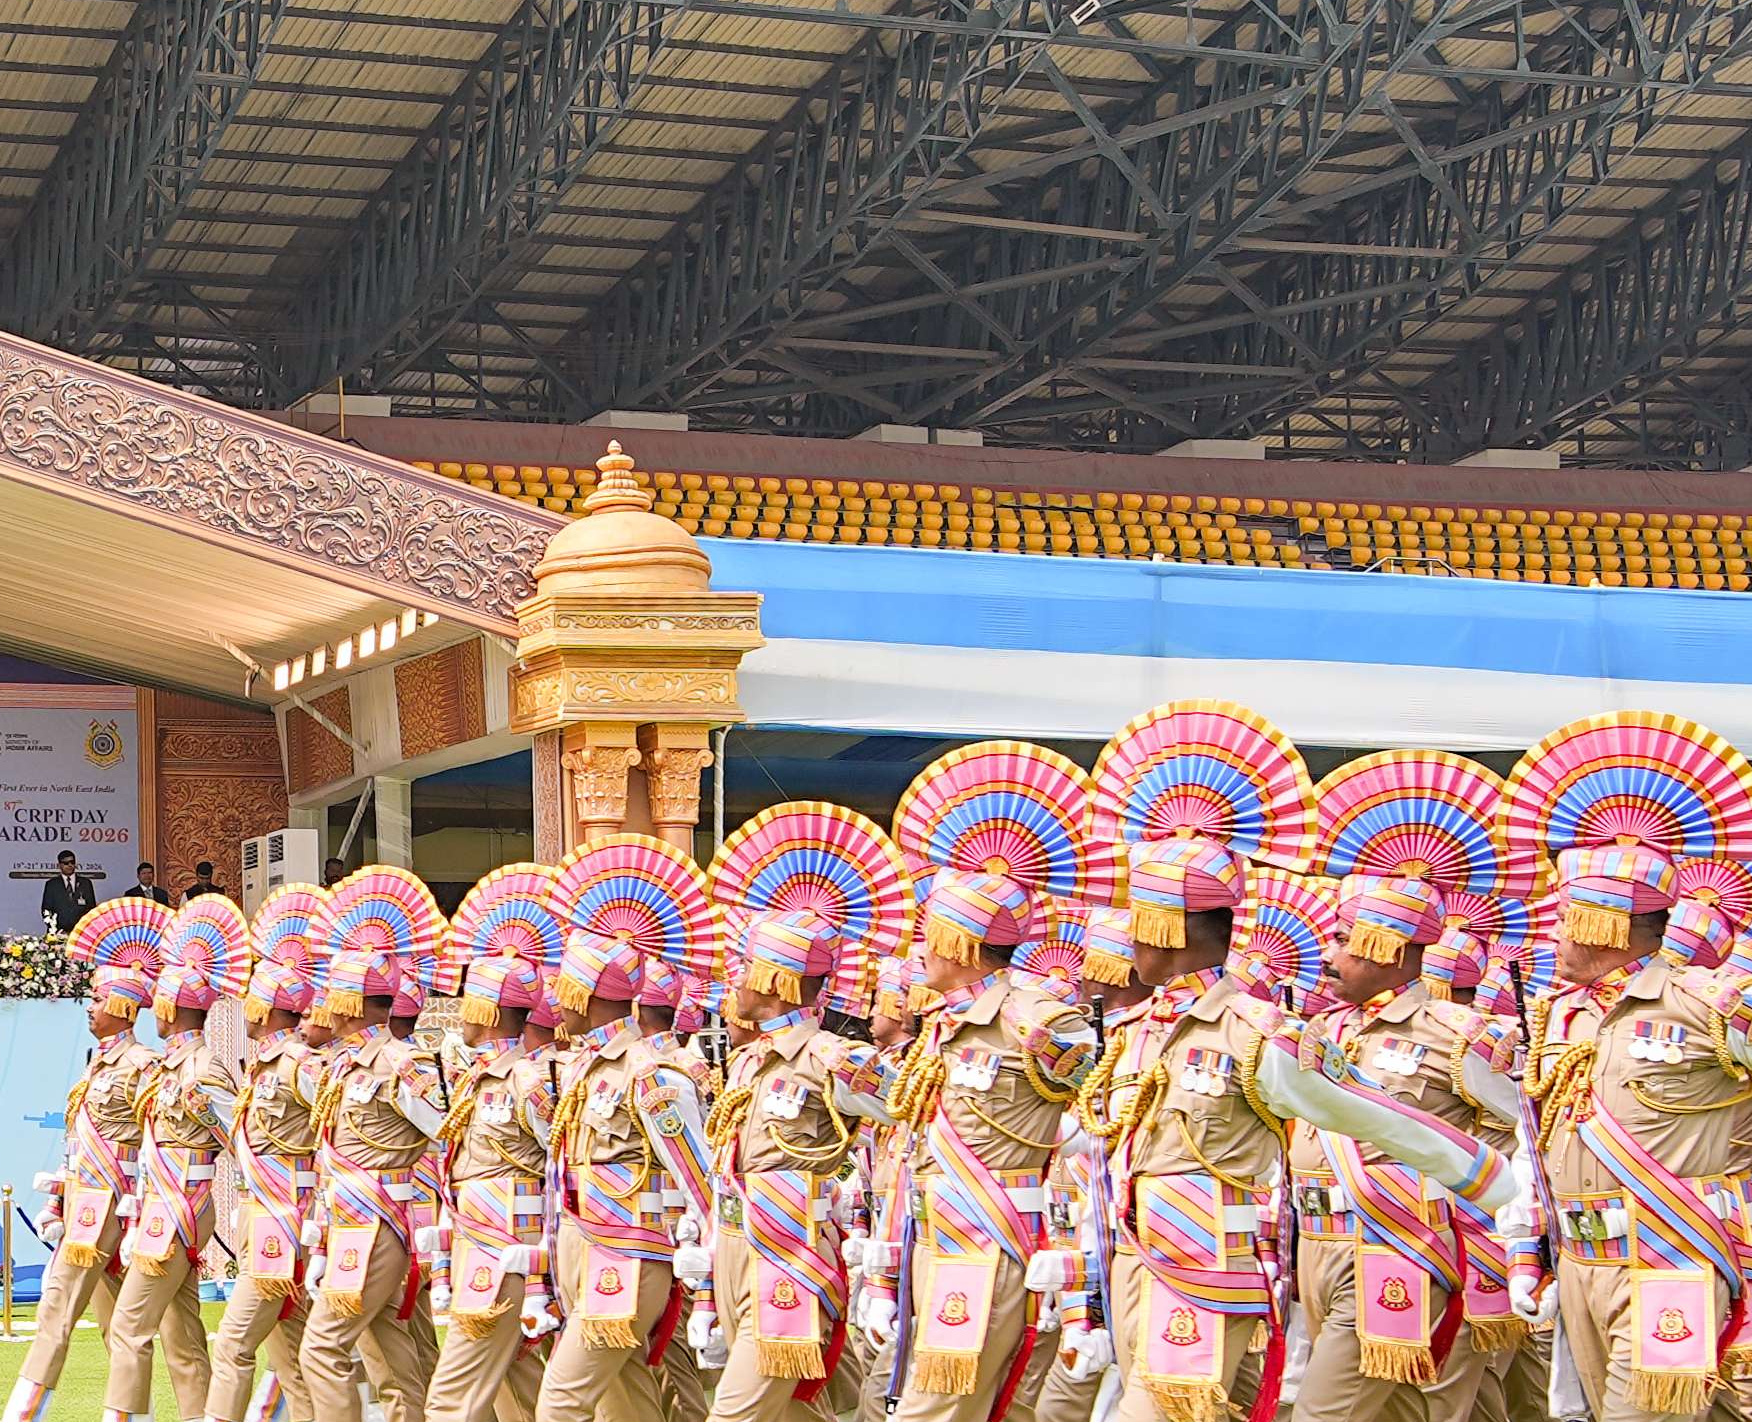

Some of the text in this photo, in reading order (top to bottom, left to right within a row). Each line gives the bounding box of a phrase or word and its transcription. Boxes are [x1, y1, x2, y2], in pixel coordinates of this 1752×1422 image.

[19, 784, 38, 792] Ever
[49, 784, 73, 793] North
[76, 785, 93, 793] East
[94, 785, 116, 793] India
[14, 808, 109, 824] CRPF DAY
[79, 827, 129, 843] 2026
